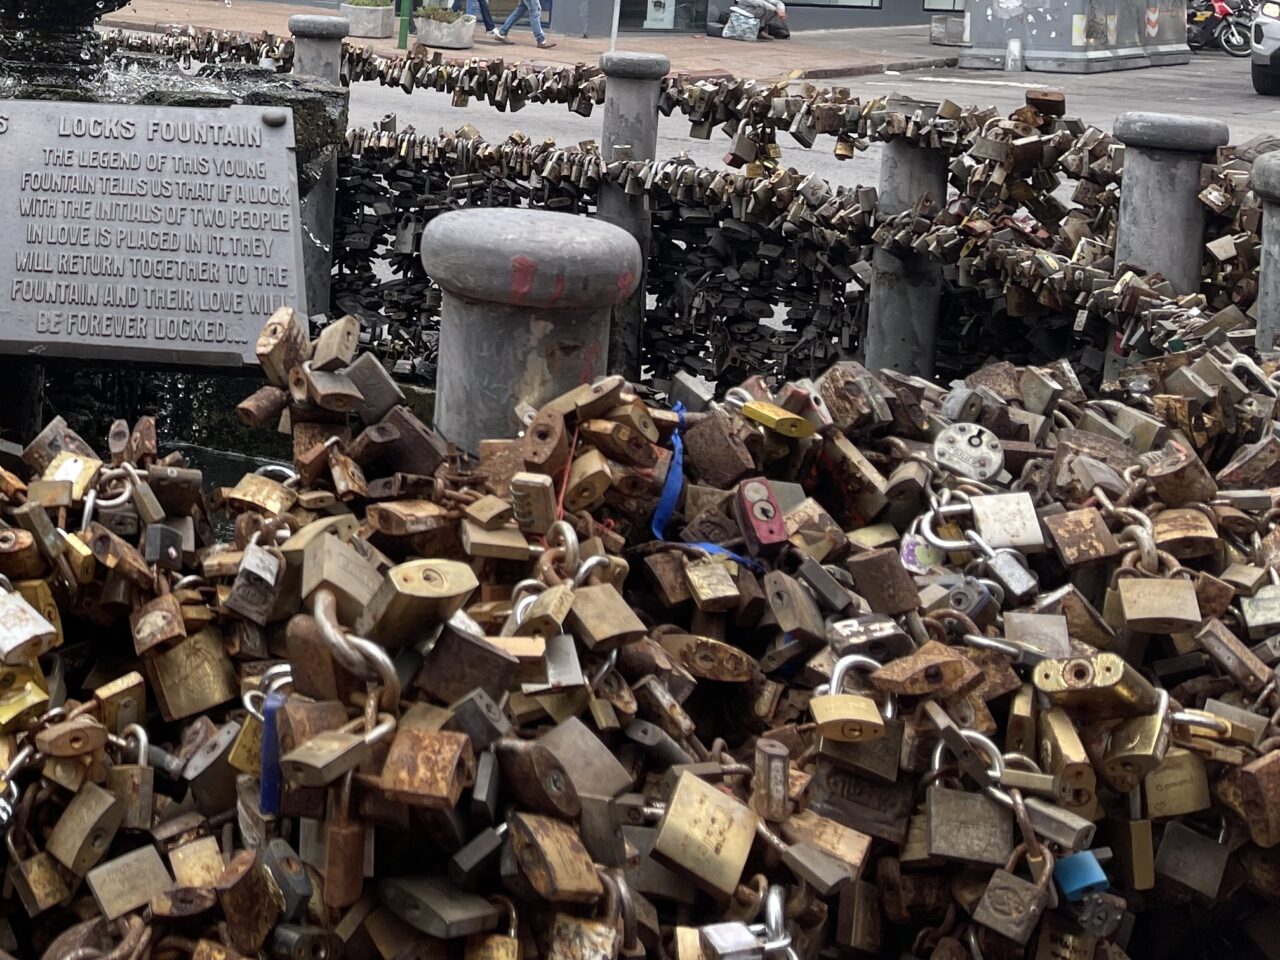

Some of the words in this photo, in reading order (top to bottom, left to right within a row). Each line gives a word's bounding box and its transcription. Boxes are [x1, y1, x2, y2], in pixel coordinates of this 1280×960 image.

[58, 115, 136, 140] LOCKS
[147, 120, 262, 147] FOUNTAIN
[43, 148, 74, 167] THE
[78, 149, 140, 171] LEGEND
[146, 153, 167, 172] OF
[172, 154, 209, 175] THIS
[212, 157, 267, 179] YOUNG
[20, 172, 96, 194] FOUNTAIN
[100, 176, 147, 197] TELLS
[151, 179, 173, 199] US
[176, 181, 214, 202] THAT
[218, 182, 233, 202] IF
[235, 184, 246, 203] A
[249, 185, 291, 207] LOCK
[19, 196, 57, 218] WITH
[61, 198, 91, 220] THE
[95, 201, 162, 224] INITIALS
[166, 205, 187, 225] OF
[191, 206, 226, 228] TWO
[230, 209, 290, 232] PEOPLE
[26, 224, 43, 244] IN
[46, 225, 90, 246] LOVE
[95, 227, 112, 247] IS
[116, 228, 180, 253] PLACED
[185, 233, 201, 254] IN
[230, 236, 274, 258] THEY
[15, 251, 53, 274] WILL
[57, 254, 124, 277] RETURN
[129, 257, 220, 284] TOGETHER
[224, 263, 249, 284] TO
[254, 265, 289, 287] THE
[10, 279, 99, 306] FOUNTAIN
[103, 286, 139, 307] AND
[144, 287, 194, 310] THEIR
[199, 290, 243, 313] LOVE
[36, 310, 61, 334] BE
[67, 313, 148, 339] FOREVER
